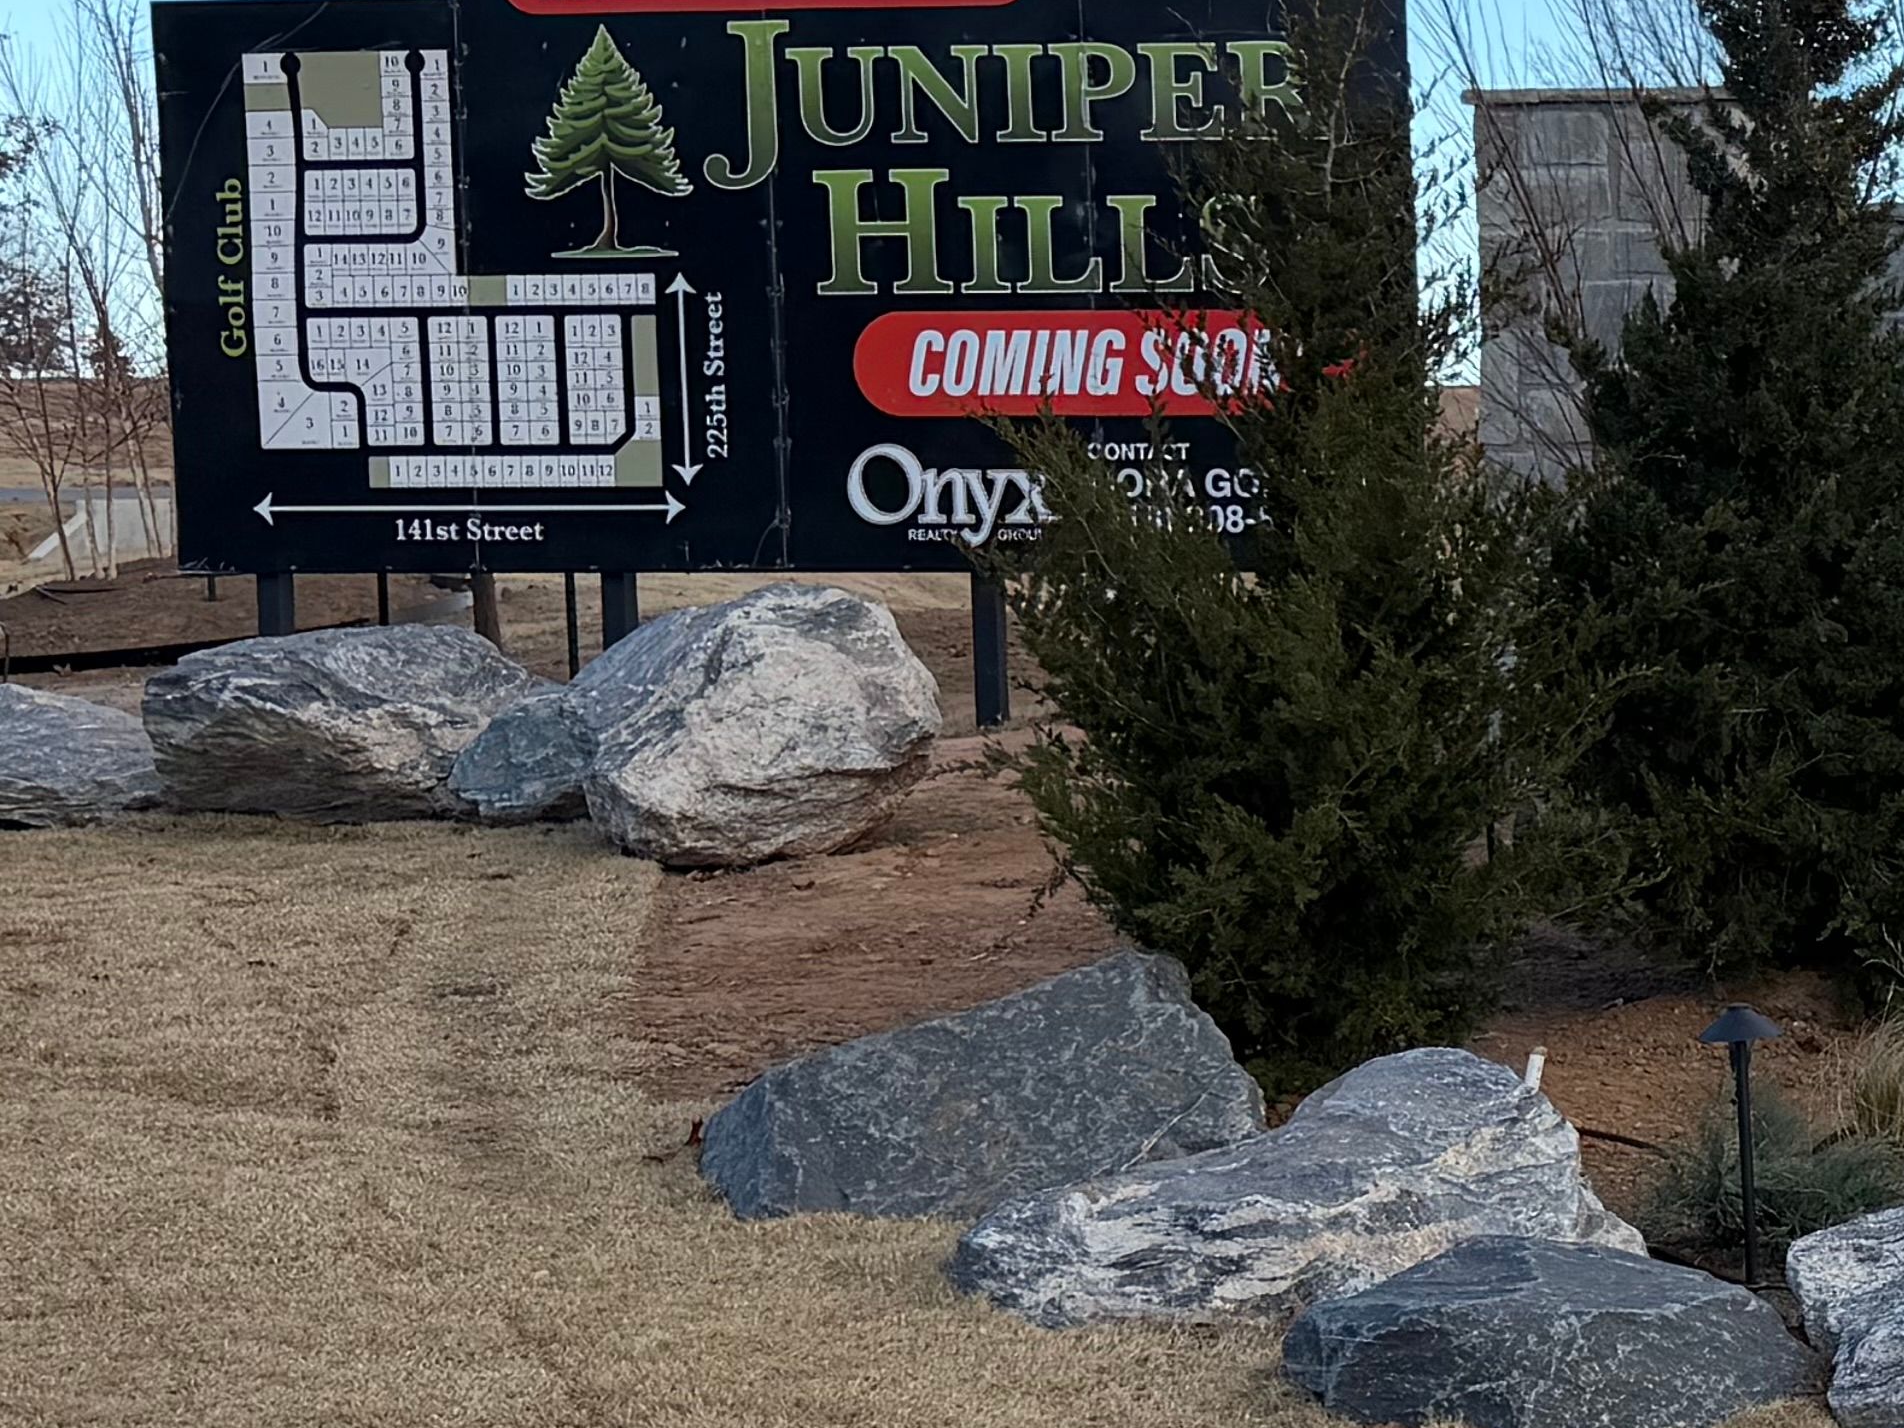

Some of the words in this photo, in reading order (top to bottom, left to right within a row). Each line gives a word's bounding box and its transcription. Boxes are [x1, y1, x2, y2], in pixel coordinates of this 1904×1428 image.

[384, 56, 399, 68] 10
[430, 84, 439, 96] 2
[392, 98, 401, 111] 8
[432, 105, 440, 117] 3
[266, 120, 272, 131] 4
[434, 127, 440, 139] 4
[266, 145, 274, 157] 3
[311, 141, 319, 154] 2
[334, 137, 342, 149] 3
[352, 137, 360, 149] 4
[371, 137, 379, 148] 5
[394, 141, 403, 151] 6
[434, 147, 442, 159] 5
[267, 172, 275, 184] 2
[329, 178, 338, 190] 2
[348, 178, 356, 190] 3
[365, 178, 373, 189] 4
[384, 177, 392, 188] 5
[402, 177, 410, 188] 6
[435, 172, 443, 183] 6
[435, 192, 443, 204] 7
[307, 210, 322, 222] 12
[328, 210, 341, 222] 11
[346, 210, 361, 221] 10
[365, 210, 374, 222] 9
[384, 209, 393, 221] 8
[403, 208, 411, 220] 7
[435, 211, 444, 221] 8
[216, 178, 244, 265] Club
[266, 225, 281, 237] 10
[437, 238, 446, 250] 9
[270, 252, 278, 264] 9
[334, 254, 347, 265] 14
[352, 253, 366, 265] 13
[371, 253, 386, 265] 12
[390, 253, 402, 264] 11
[412, 253, 426, 264] 10
[315, 270, 323, 281] 2
[271, 277, 279, 289] 8
[340, 287, 348, 298] 4
[380, 286, 389, 298] 6
[400, 286, 407, 297] 7
[416, 286, 425, 297] 8
[437, 286, 446, 297] 9
[452, 286, 467, 297] 10
[532, 284, 540, 296] 2
[550, 284, 558, 296] 3
[568, 284, 576, 296] 4
[588, 284, 596, 295] 5
[605, 283, 614, 295] 6
[624, 283, 632, 295] 7
[641, 283, 650, 294] 8
[315, 291, 323, 302] 3
[218, 275, 247, 357] Golf
[272, 307, 279, 319] 7
[336, 325, 345, 337] 2
[356, 325, 365, 337] 3
[377, 325, 385, 337] 4
[401, 322, 409, 333] 5
[438, 322, 452, 334] 12
[504, 322, 519, 334] 12
[588, 325, 597, 337] 2
[607, 324, 615, 336] 3
[703, 291, 725, 376] Street
[274, 334, 282, 345] 6
[402, 345, 410, 356] 6
[439, 345, 451, 357] 11
[506, 344, 518, 355] 11
[537, 344, 545, 356] 2
[574, 351, 588, 364] 12
[604, 351, 611, 363] 4
[908, 328, 1126, 397] COMING
[275, 360, 283, 372] 5
[311, 359, 325, 370] 16
[356, 358, 370, 370] 14
[404, 364, 410, 376] 7
[439, 364, 454, 376] 10
[506, 364, 521, 375] 10
[575, 371, 588, 383] 11
[372, 384, 387, 396] 13
[404, 387, 413, 397] 8
[444, 385, 451, 396] 9
[509, 384, 518, 396] 9
[539, 385, 547, 396] 4
[576, 394, 591, 405] 10
[606, 393, 614, 404] 6
[340, 401, 348, 412] 2
[405, 405, 414, 416] 9
[444, 405, 452, 416] 8
[510, 403, 519, 414] 8
[373, 410, 388, 421] 12
[705, 384, 728, 458] 225th
[306, 417, 314, 429] 3
[574, 420, 582, 431] 9
[591, 420, 600, 431] 8
[611, 419, 618, 431] 7
[645, 423, 653, 435] 2
[374, 430, 388, 441] 11
[404, 426, 417, 438] 10
[445, 426, 453, 437] 7
[512, 425, 520, 436] 7
[541, 425, 550, 436] 6
[1087, 442, 1190, 460] CONTCT
[414, 466, 422, 477] 2
[433, 465, 440, 477] 3
[450, 466, 458, 477] 4
[488, 466, 497, 477] 6
[507, 466, 514, 477] 7
[525, 466, 534, 476] 8
[544, 466, 553, 477] 9
[561, 466, 575, 477] 10
[582, 466, 595, 477] 11
[599, 465, 613, 477] 12
[847, 443, 1062, 548] Onyx
[395, 518, 460, 541] 141st
[466, 518, 545, 541] Street
[998, 528, 1042, 541] GROU
